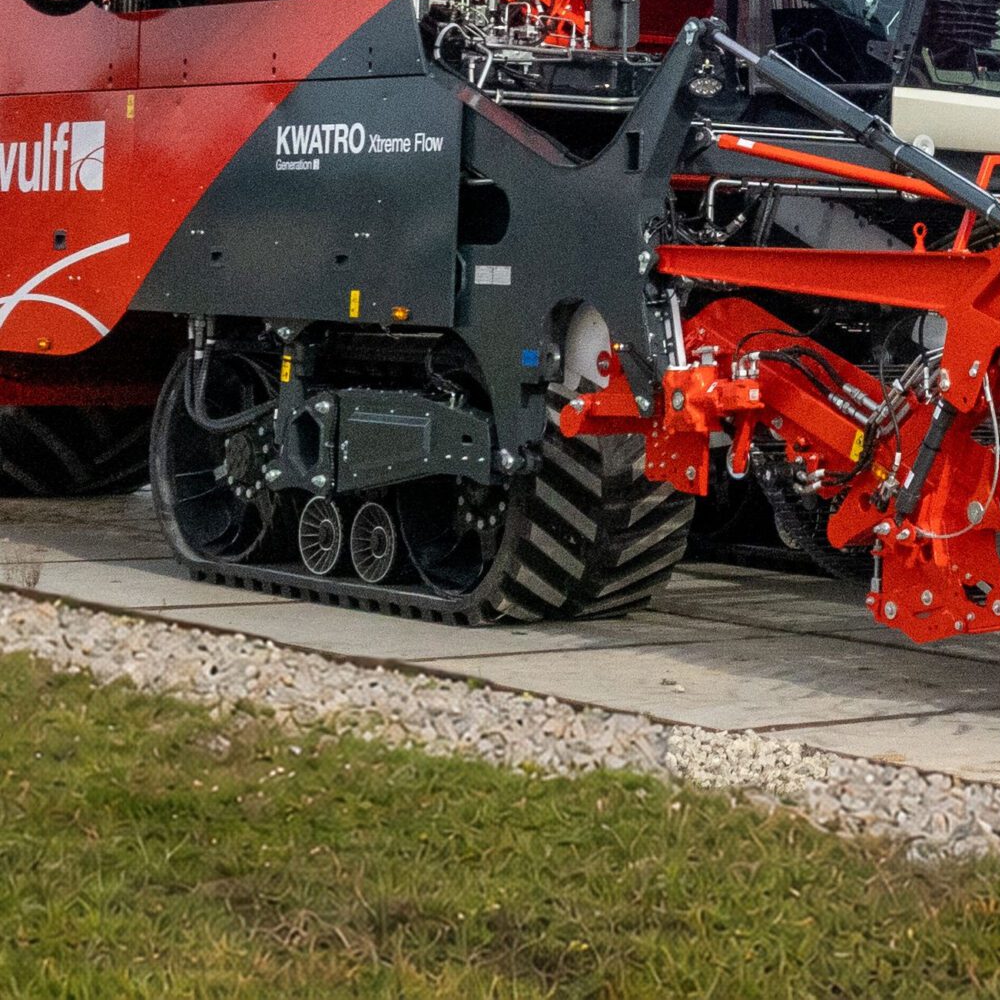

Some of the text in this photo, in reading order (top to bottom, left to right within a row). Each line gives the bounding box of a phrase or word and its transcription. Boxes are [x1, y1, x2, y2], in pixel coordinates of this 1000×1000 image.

[276, 122, 444, 155] KWATRO Xtreme Flow
